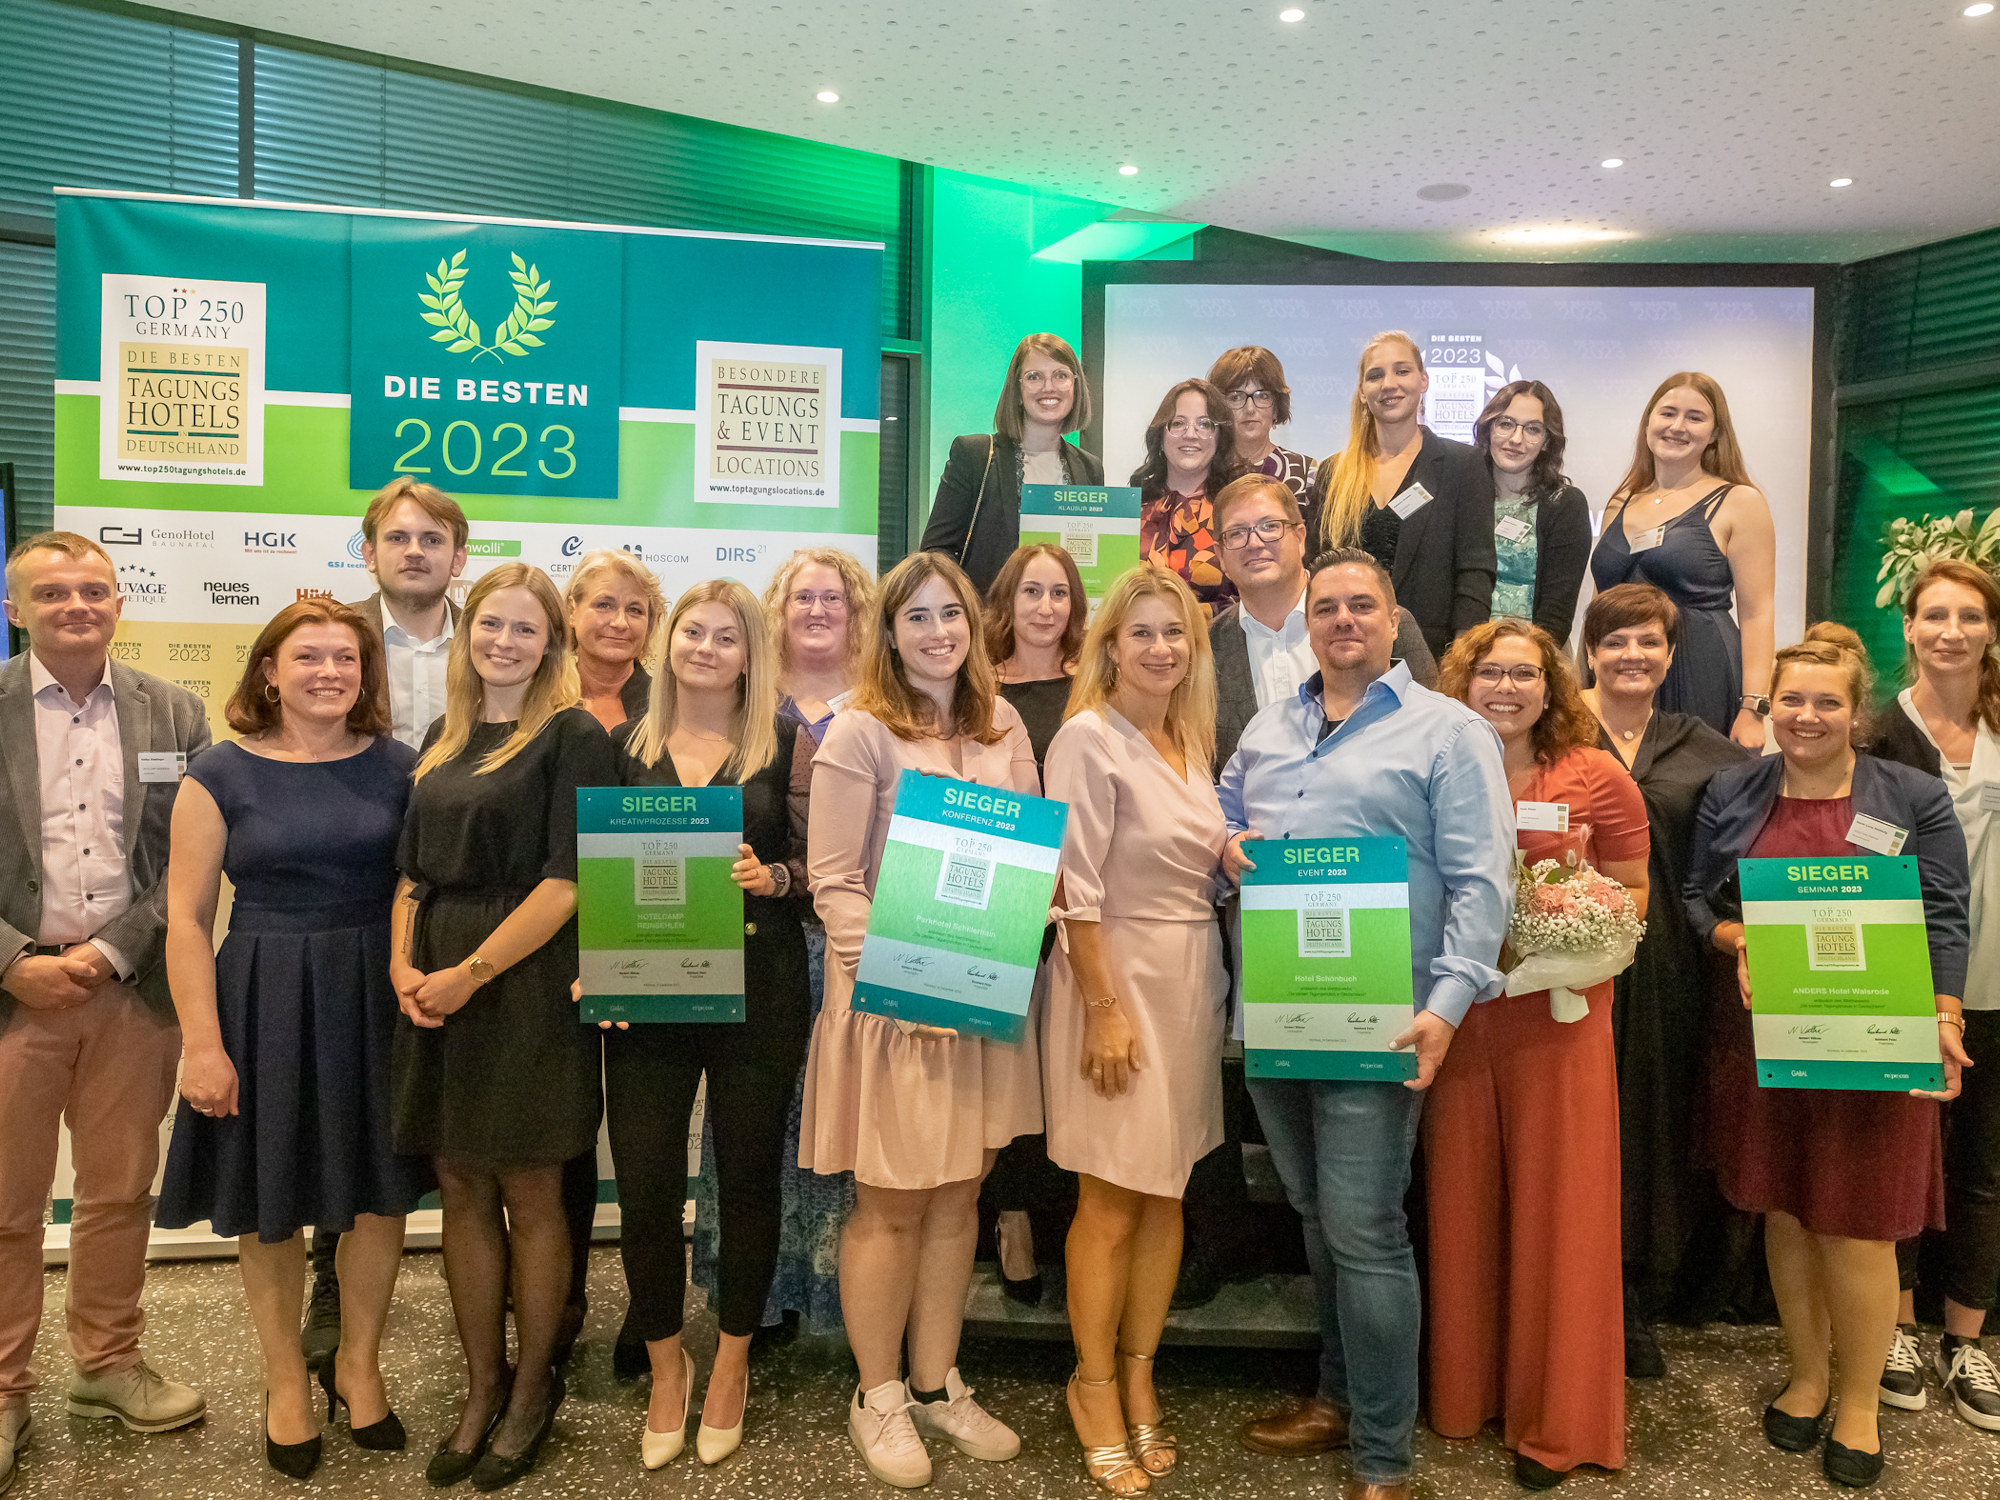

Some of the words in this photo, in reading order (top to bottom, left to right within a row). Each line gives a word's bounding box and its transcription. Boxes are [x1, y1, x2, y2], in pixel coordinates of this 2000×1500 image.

[124, 294, 187, 319] TOP
[199, 299, 244, 324] 250
[136, 321, 231, 339] GERMANY
[128, 350, 157, 364] DIE
[169, 352, 241, 368] BESTEN
[1431, 348, 1481, 363] 2023
[718, 366, 820, 384] BESONDERE
[1435, 375, 1457, 384] TOP
[1461, 375, 1476, 384] 250
[127, 377, 240, 402] TAGUNGS
[384, 375, 441, 399] DIE
[456, 378, 588, 407] BESTEN
[717, 393, 819, 419] TAGUNGS
[1434, 402, 1475, 410] TAGUNGS
[127, 401, 240, 430] HOTELS
[1434, 410, 1475, 420] HOTELS
[717, 420, 731, 440] &
[741, 421, 819, 444] EVENT
[127, 439, 239, 456] DEUTSCHLAND
[393, 418, 577, 479] 2023
[118, 464, 247, 476] www.top250tagungshotels.de
[716, 456, 819, 477] LOCATIONS
[709, 485, 825, 496] www.toptagungslocations.de
[1053, 490, 1108, 503] SIEGER
[151, 529, 215, 540] GenoHotel
[244, 531, 296, 547] HGK
[152, 540, 215, 549] BAUNATAL
[465, 543, 501, 554] nwalli
[645, 554, 689, 563] HOSCOM
[716, 547, 756, 562] DIRS
[550, 564, 577, 573] CERTI
[117, 582, 167, 594] UVAGE
[204, 581, 250, 593] neues
[124, 594, 167, 604] ETIQUE
[212, 593, 260, 606] lernen
[107, 647, 141, 660] 023
[169, 649, 211, 662] 2023
[622, 797, 697, 812] SIEGER
[943, 787, 1021, 819] SIEGER
[610, 818, 687, 826] KREATIVPROZESSE
[690, 817, 710, 825] 2023
[941, 810, 994, 827] KONFERENZ
[995, 820, 1015, 831] 2023
[642, 842, 661, 850] TOP
[664, 842, 678, 850] 250
[954, 837, 976, 849] TOP
[977, 842, 993, 852] 250
[1283, 846, 1360, 864] SIEGER
[1297, 869, 1324, 877] EVENT
[1327, 868, 1347, 876] 2023
[1787, 865, 1869, 881] SIEGER
[643, 877, 678, 886] HOTELS
[947, 872, 984, 889] HOTELS
[1841, 885, 1863, 893] 2023
[1304, 893, 1324, 902] TOP
[1327, 893, 1342, 902] 250
[1812, 909, 1833, 917] TOP
[1837, 909, 1852, 917] 250
[1306, 928, 1342, 937] HOTELS
[1817, 943, 1856, 951] HOTELS
